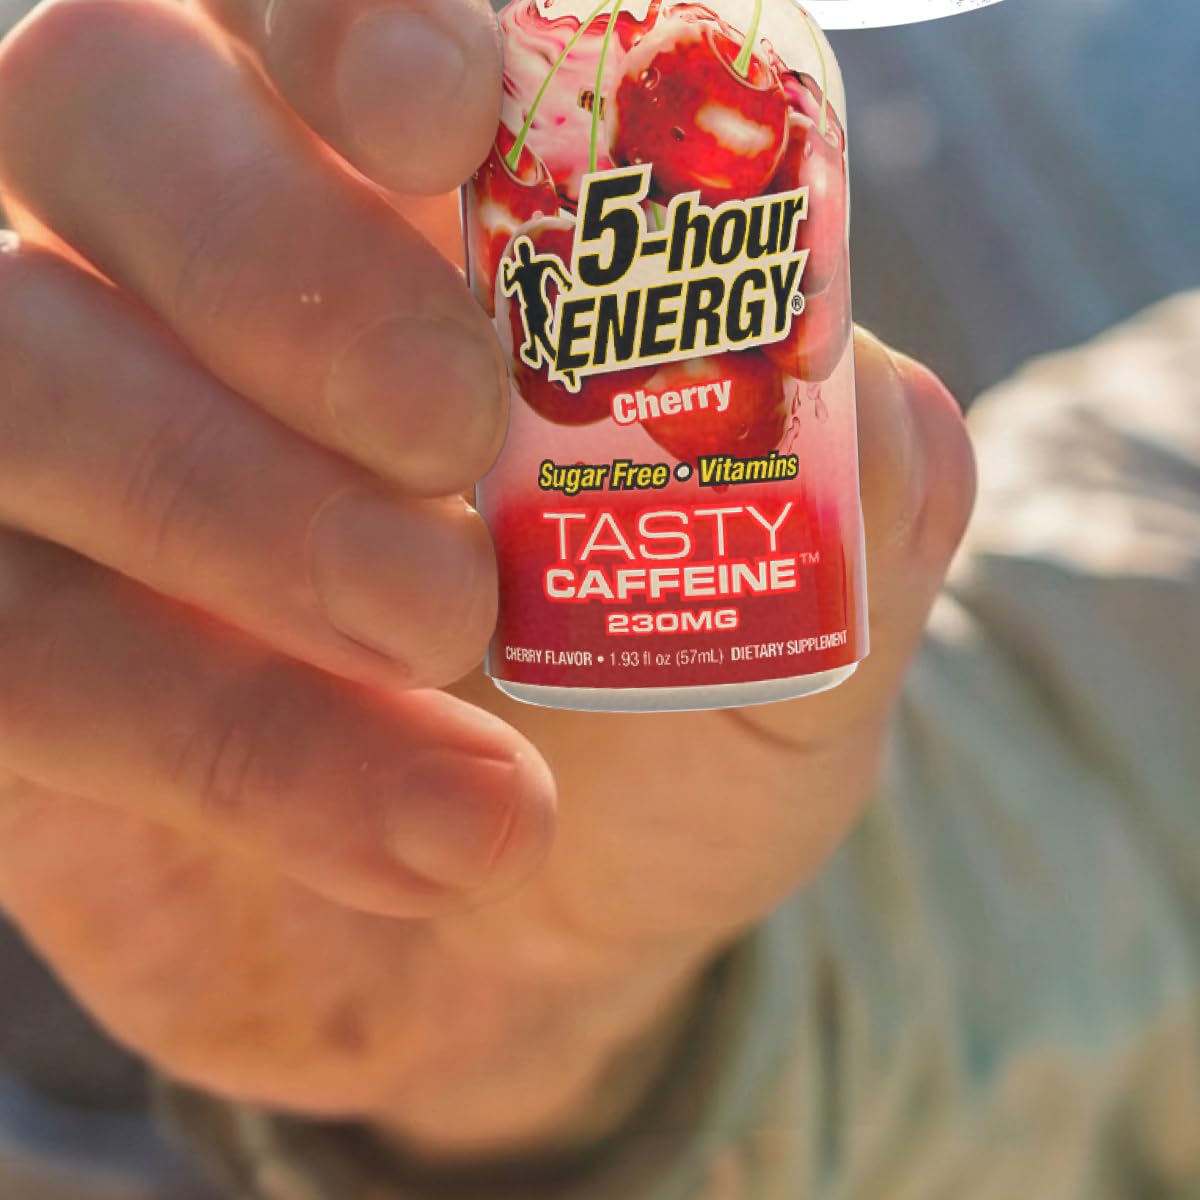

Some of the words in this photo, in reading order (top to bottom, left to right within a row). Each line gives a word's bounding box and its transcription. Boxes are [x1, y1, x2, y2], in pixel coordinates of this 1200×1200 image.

[577, 172, 804, 287] 5-hour
[611, 379, 732, 424] Cherry
[538, 460, 606, 496] Sugar
[611, 461, 668, 489] Free
[699, 452, 799, 487] Vitamins
[542, 501, 793, 562] TASTY
[545, 557, 797, 600] CAFFEINE
[607, 609, 739, 634] 230MG
[505, 645, 542, 664] CHERRY
[545, 650, 593, 666] FLAVOR
[610, 650, 640, 667] 1.93
[643, 650, 651, 666] fl
[655, 653, 671, 666] oz
[676, 649, 724, 667] (57mL)
[730, 641, 785, 661] DIETARY
[787, 629, 848, 656] SUPPLEMENT
